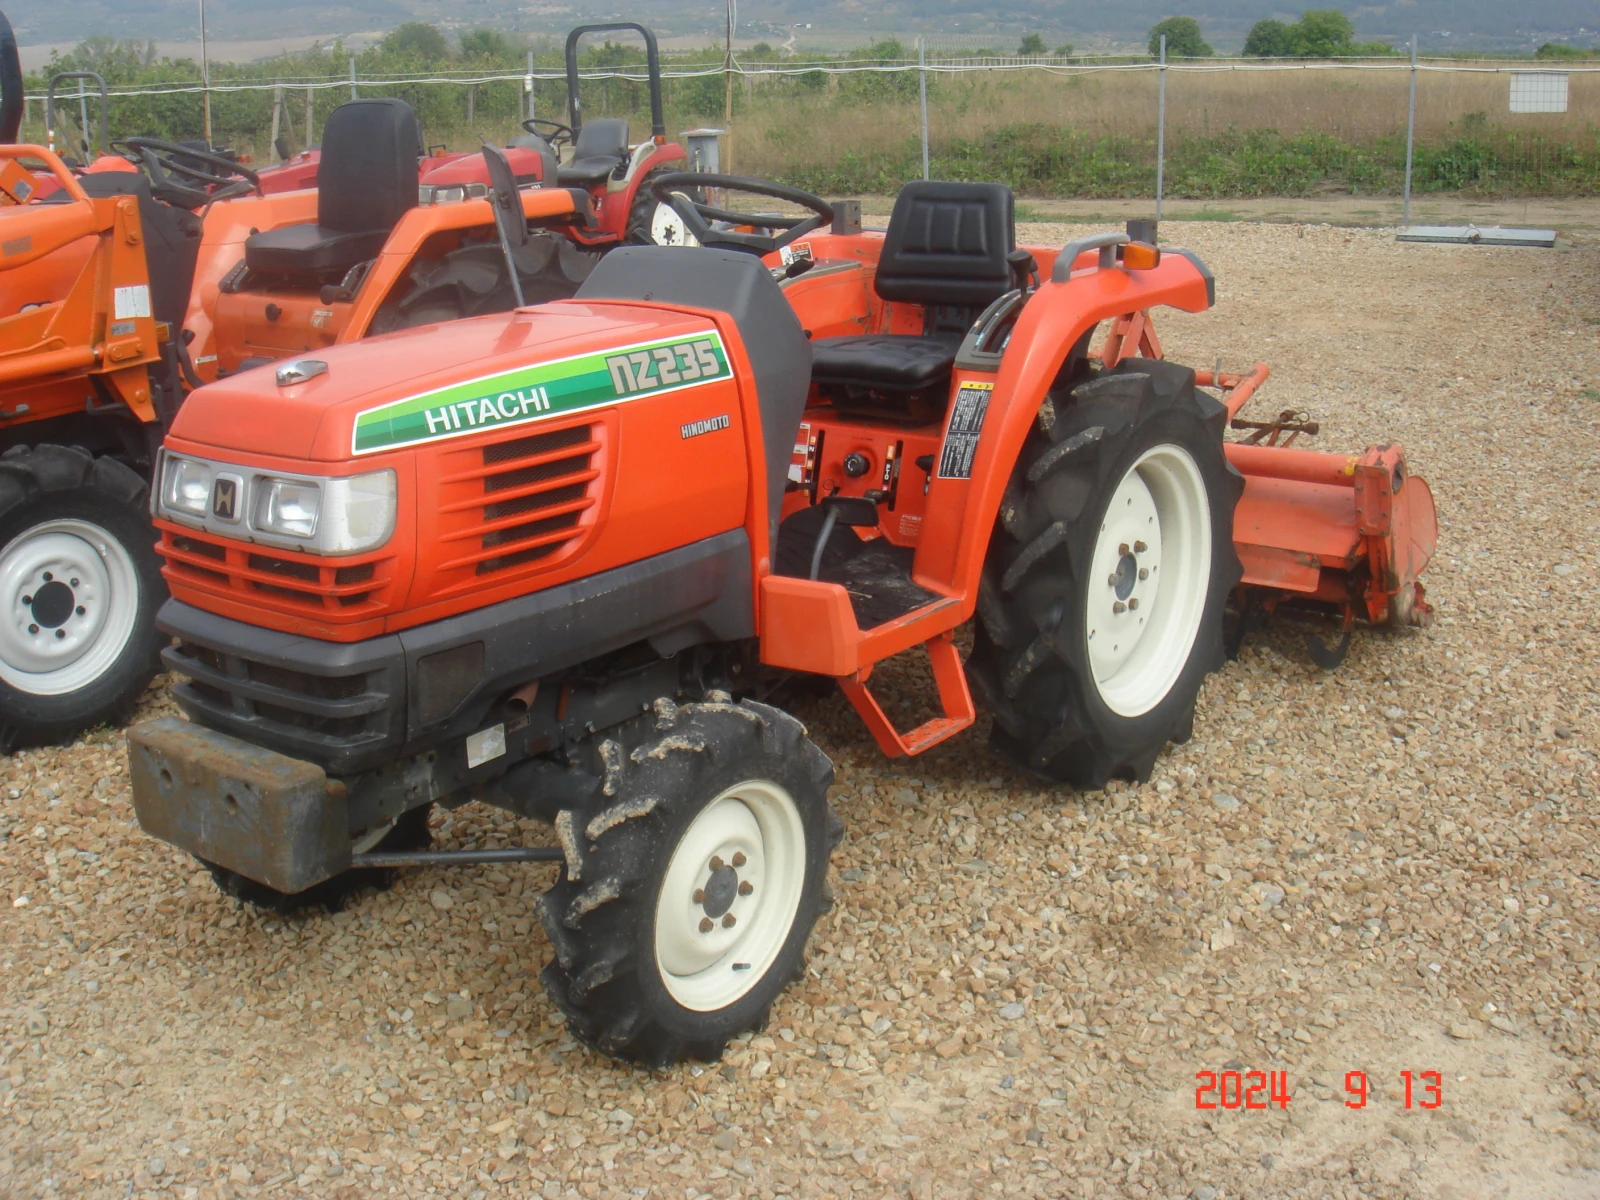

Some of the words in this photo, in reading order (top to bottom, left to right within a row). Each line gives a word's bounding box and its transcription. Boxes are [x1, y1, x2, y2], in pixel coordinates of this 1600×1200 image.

[424, 387, 550, 434] HITACHI
[681, 414, 730, 439] HINOMOTO
[883, 463, 891, 480] PTO
